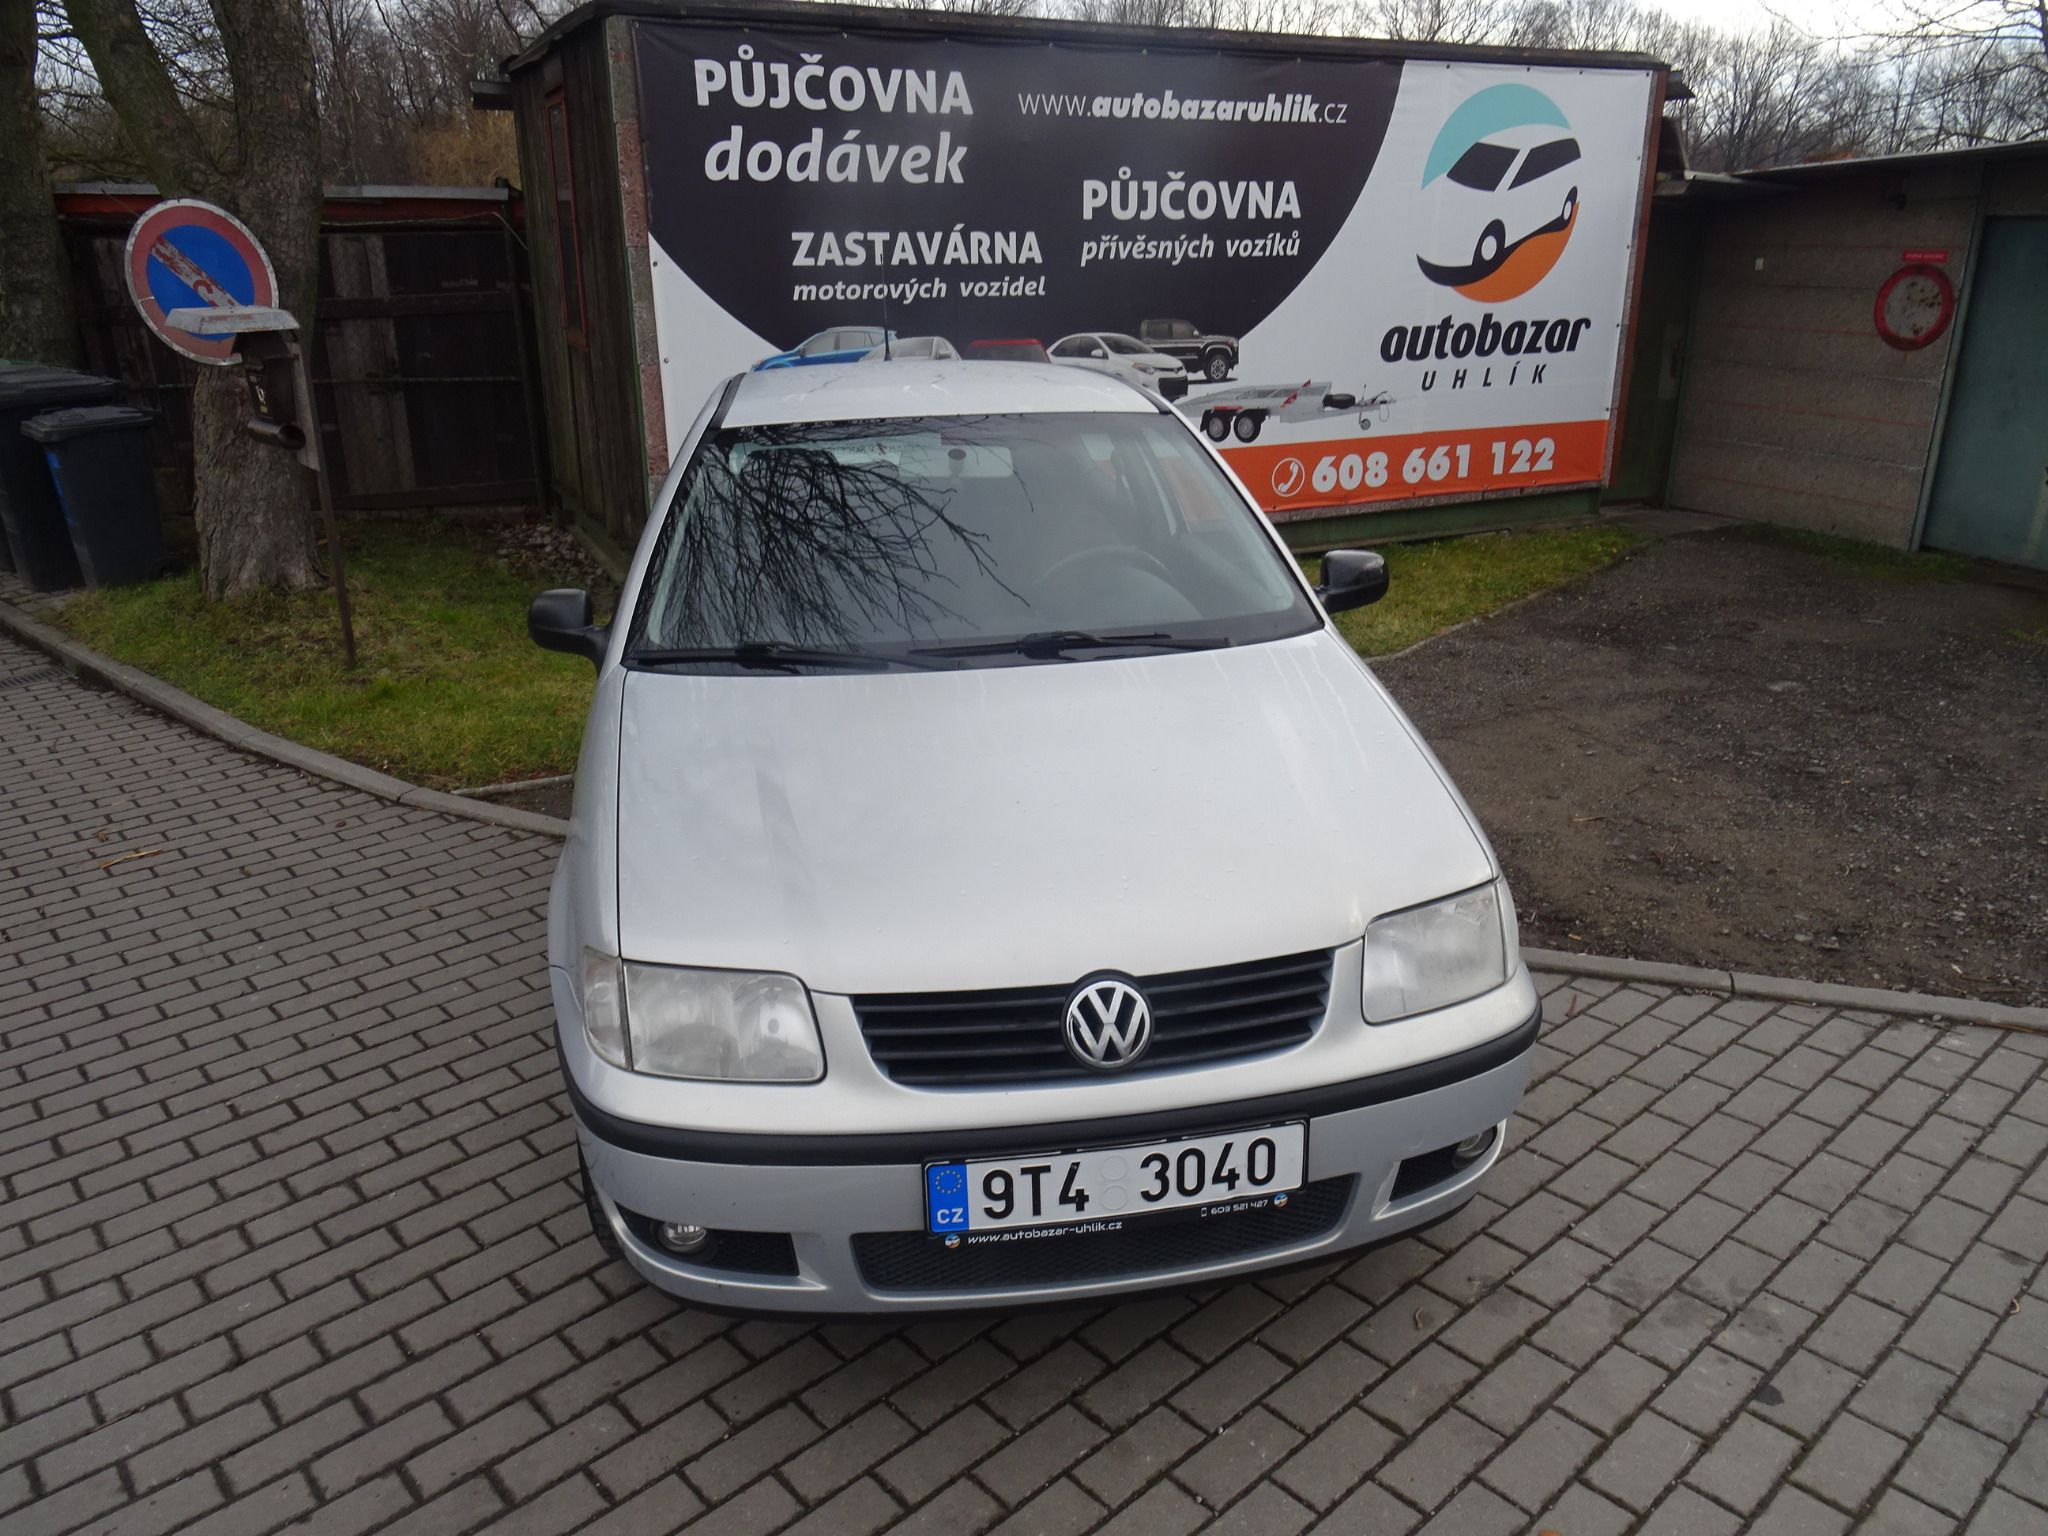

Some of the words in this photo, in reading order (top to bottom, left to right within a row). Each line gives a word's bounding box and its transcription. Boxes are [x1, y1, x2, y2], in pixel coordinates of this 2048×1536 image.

[694, 44, 974, 115] PŮJČOVNA
[1018, 90, 1348, 124] www.autobazaruhlik.cz
[704, 125, 968, 184] dodávek
[1082, 166, 1301, 220] PŮJČOVNA
[791, 223, 1043, 266] ZASTAVÁRNA
[1080, 234, 1214, 267] přívěsných
[1225, 230, 1301, 257] vozíků
[793, 278, 947, 304] motorových
[959, 276, 1046, 297] vozidel
[1380, 313, 1592, 363] autobazar
[1421, 361, 1547, 391] UHLÍK
[1311, 452, 1389, 493] 608
[1402, 444, 1471, 484] 661
[1492, 438, 1555, 475] 122
[982, 1162, 1090, 1220] 9T4
[1139, 1136, 1277, 1203] 3040
[936, 1207, 964, 1225] CZ
[967, 1221, 1123, 1245] www.autobazar-uhlik.cz
